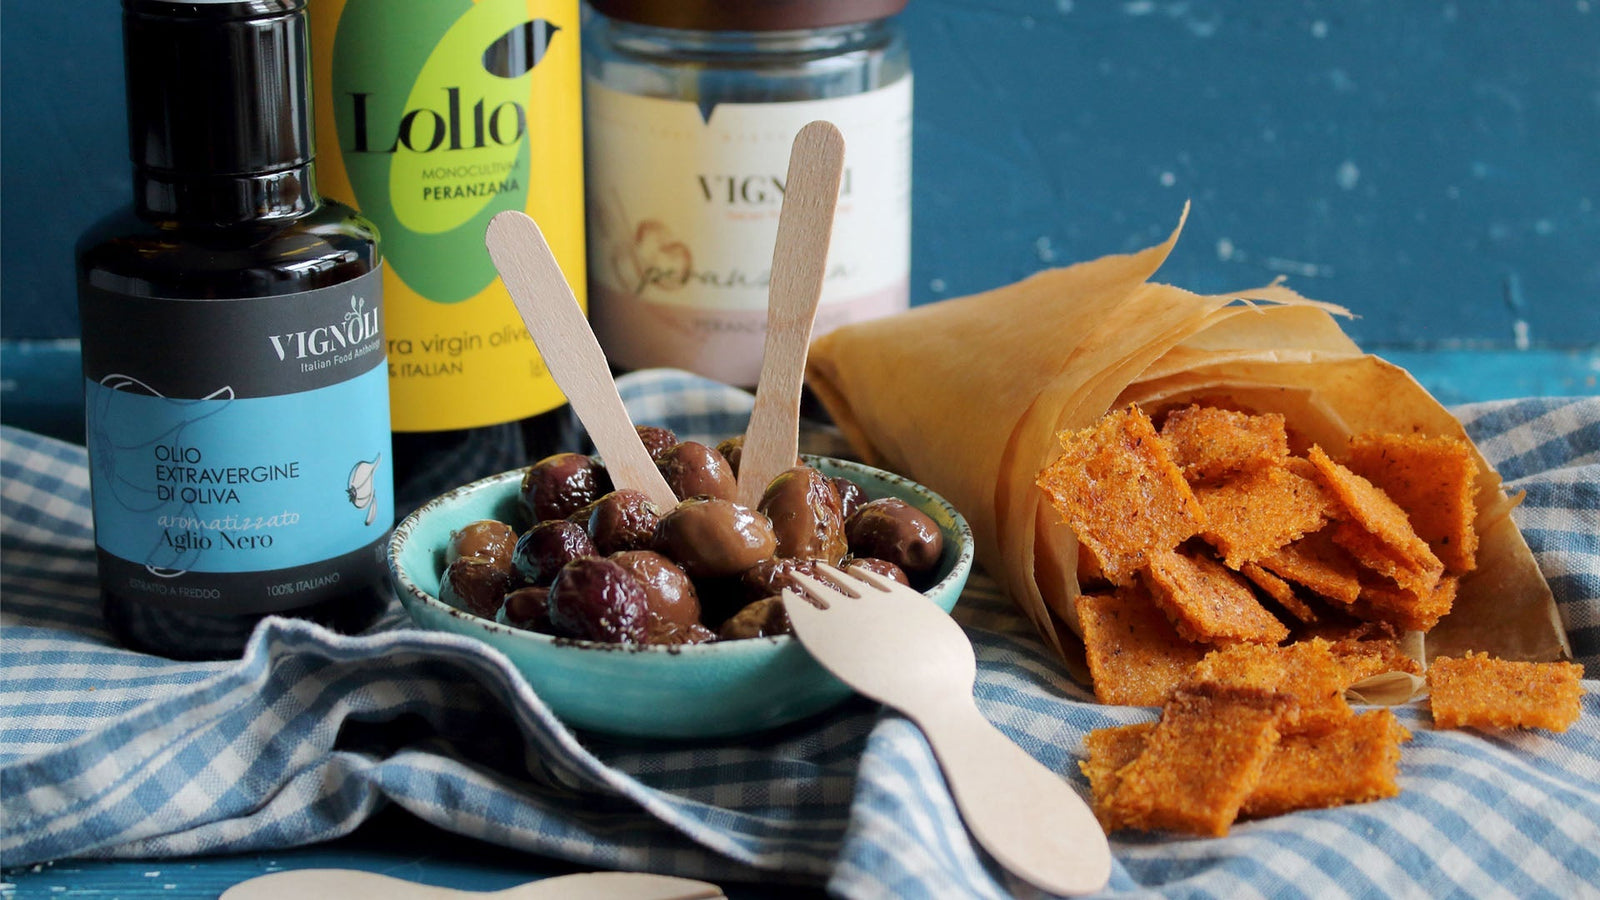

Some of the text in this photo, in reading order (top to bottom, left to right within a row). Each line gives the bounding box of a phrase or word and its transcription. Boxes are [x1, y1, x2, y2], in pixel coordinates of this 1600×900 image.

[423, 178, 520, 201] PERANZANA
[268, 306, 379, 361] VIGNOLI
[421, 331, 482, 357] virgin
[301, 359, 332, 373] Italian
[333, 352, 353, 364] Food
[401, 361, 463, 378] ITALIAN
[155, 445, 201, 464] OLIO
[156, 462, 300, 484] EXTRAVERGINE
[157, 485, 240, 504] DI OLIVA
[157, 509, 300, 531] aromatizzato
[164, 528, 273, 553] Aglio Nero
[179, 586, 221, 599] FREDDO
[266, 572, 341, 597] 100% ITALIANO
